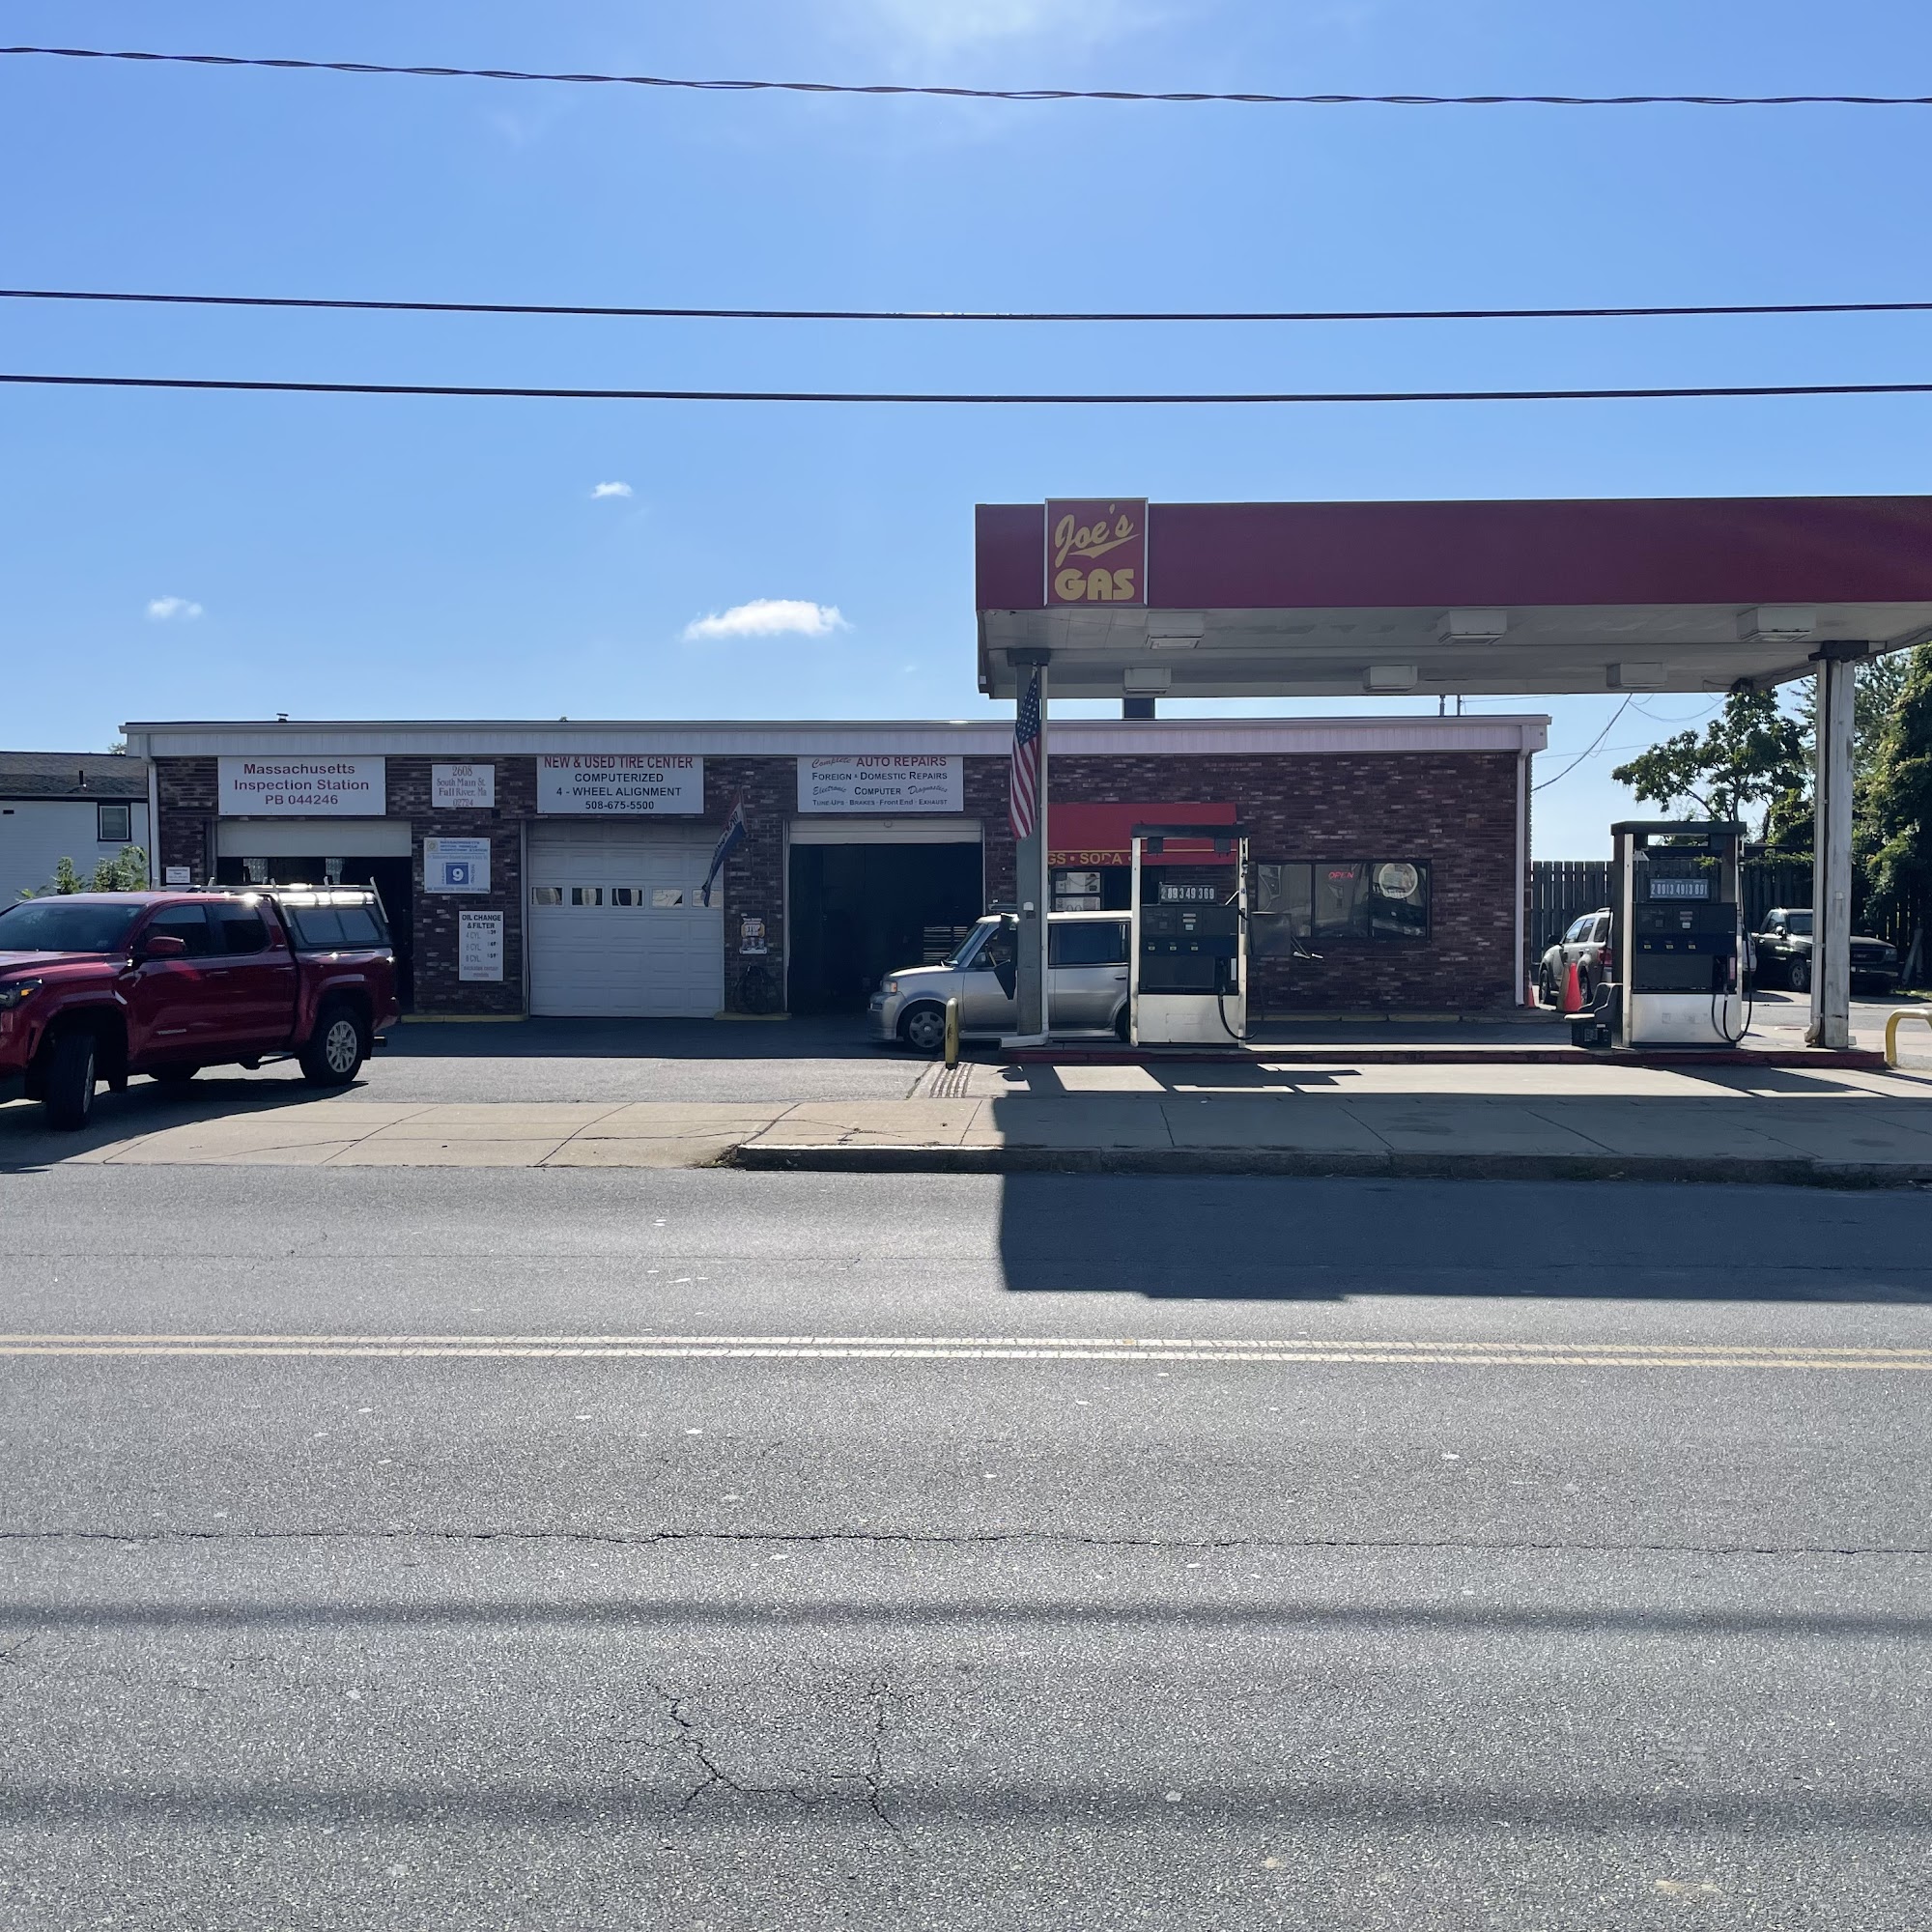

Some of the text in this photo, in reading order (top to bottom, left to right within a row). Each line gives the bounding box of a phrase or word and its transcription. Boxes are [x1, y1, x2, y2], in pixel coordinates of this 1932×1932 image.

[1054, 503, 1134, 568] Joe's
[1054, 568, 1135, 601] GAS
[544, 756, 694, 768] NEW & USED TIRE CENTER
[811, 756, 947, 769] Complete AUTO REPAIRS
[243, 763, 355, 775] Massachusetts
[452, 765, 472, 777] 2608
[575, 773, 664, 782] COMPUTERIZED
[860, 772, 906, 781] DOMESTIC
[909, 771, 948, 781] REPAIRS
[234, 780, 369, 792] Inspection Station
[437, 778, 456, 787] South
[457, 778, 476, 787] Main
[439, 787, 455, 796] Fall
[556, 787, 562, 796] 4
[573, 787, 612, 796] WHEEL
[615, 787, 682, 796] ALIGNMENT
[854, 786, 901, 796] COMPUTER
[266, 795, 338, 805] PB 044246
[585, 801, 655, 810] 508-675-5500
[452, 867, 464, 882] 9
